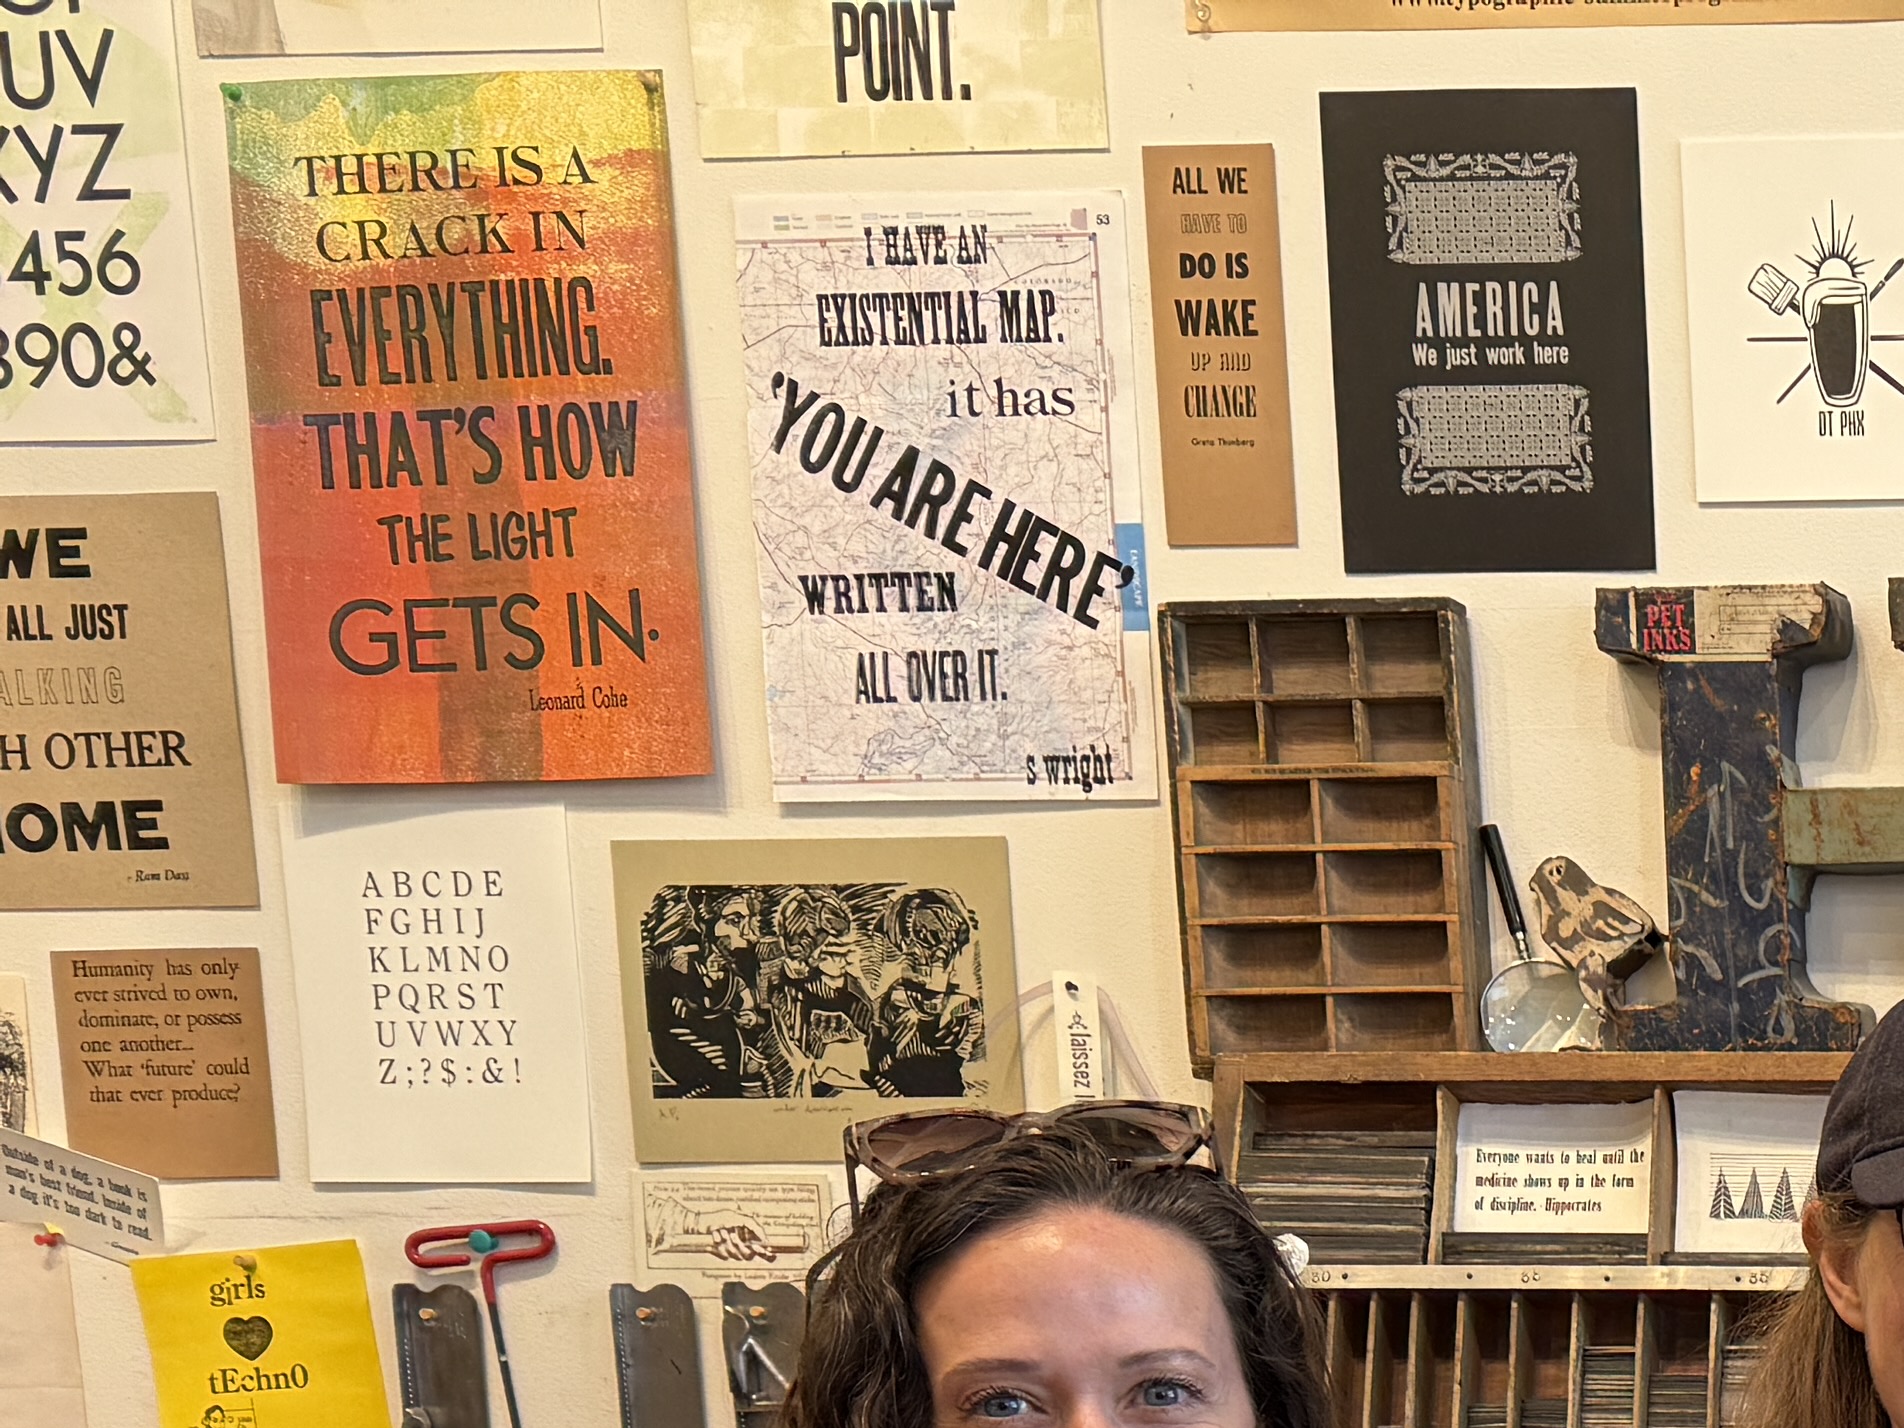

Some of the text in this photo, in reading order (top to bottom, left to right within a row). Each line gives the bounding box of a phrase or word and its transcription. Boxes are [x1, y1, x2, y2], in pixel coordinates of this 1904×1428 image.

[832, 0, 971, 102] POINT.
[816, 291, 1064, 349] EXISTENTIAL MAP.
[1175, 299, 1258, 338] WAKE
[1415, 281, 1564, 339] AMERICA
[311, 277, 613, 387] EVERYTHING.
[1412, 342, 1569, 370] We just work here
[946, 377, 1075, 418] it has
[1183, 384, 1257, 418] CHANGE
[304, 401, 638, 490] THAT'S HOW
[871, 445, 991, 555] ARE
[799, 572, 955, 615] WRITTEN
[1647, 604, 1686, 627] PET
[1643, 626, 1691, 652] INKS
[45, 730, 192, 769] OTHER
[1043, 745, 1116, 793] wright
[71, 960, 154, 981] Humanity
[165, 957, 192, 976] has
[165, 1014, 181, 1026] or
[187, 1012, 242, 1032] possess
[1070, 1033, 1092, 1088] laissez
[1476, 1148, 1519, 1166] Everyone
[210, 1274, 266, 1308] girls
